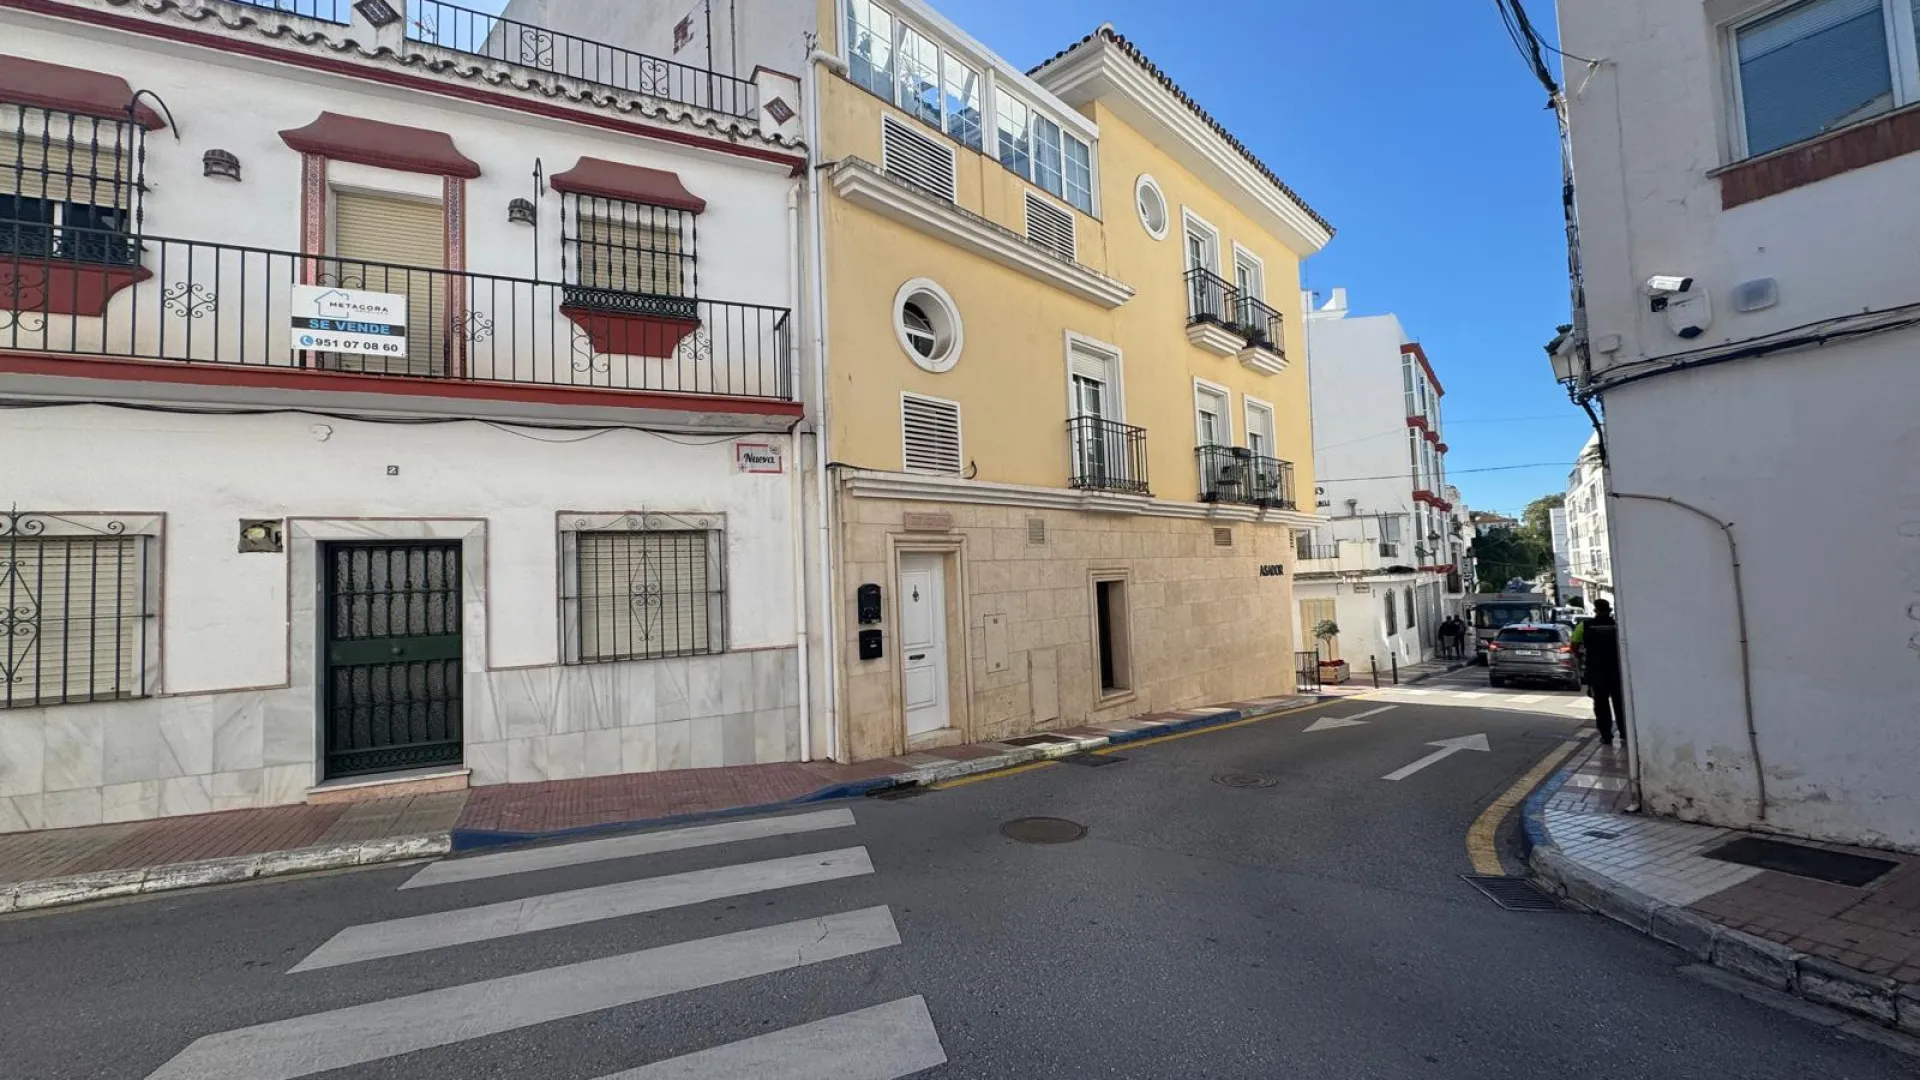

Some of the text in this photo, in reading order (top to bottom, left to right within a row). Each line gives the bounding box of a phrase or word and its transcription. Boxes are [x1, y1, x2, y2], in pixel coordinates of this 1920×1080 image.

[329, 302, 389, 312] METAGORA
[309, 318, 391, 334] SE VENDE
[315, 338, 398, 352] 951 07 08 60
[743, 452, 775, 464] Nueva
